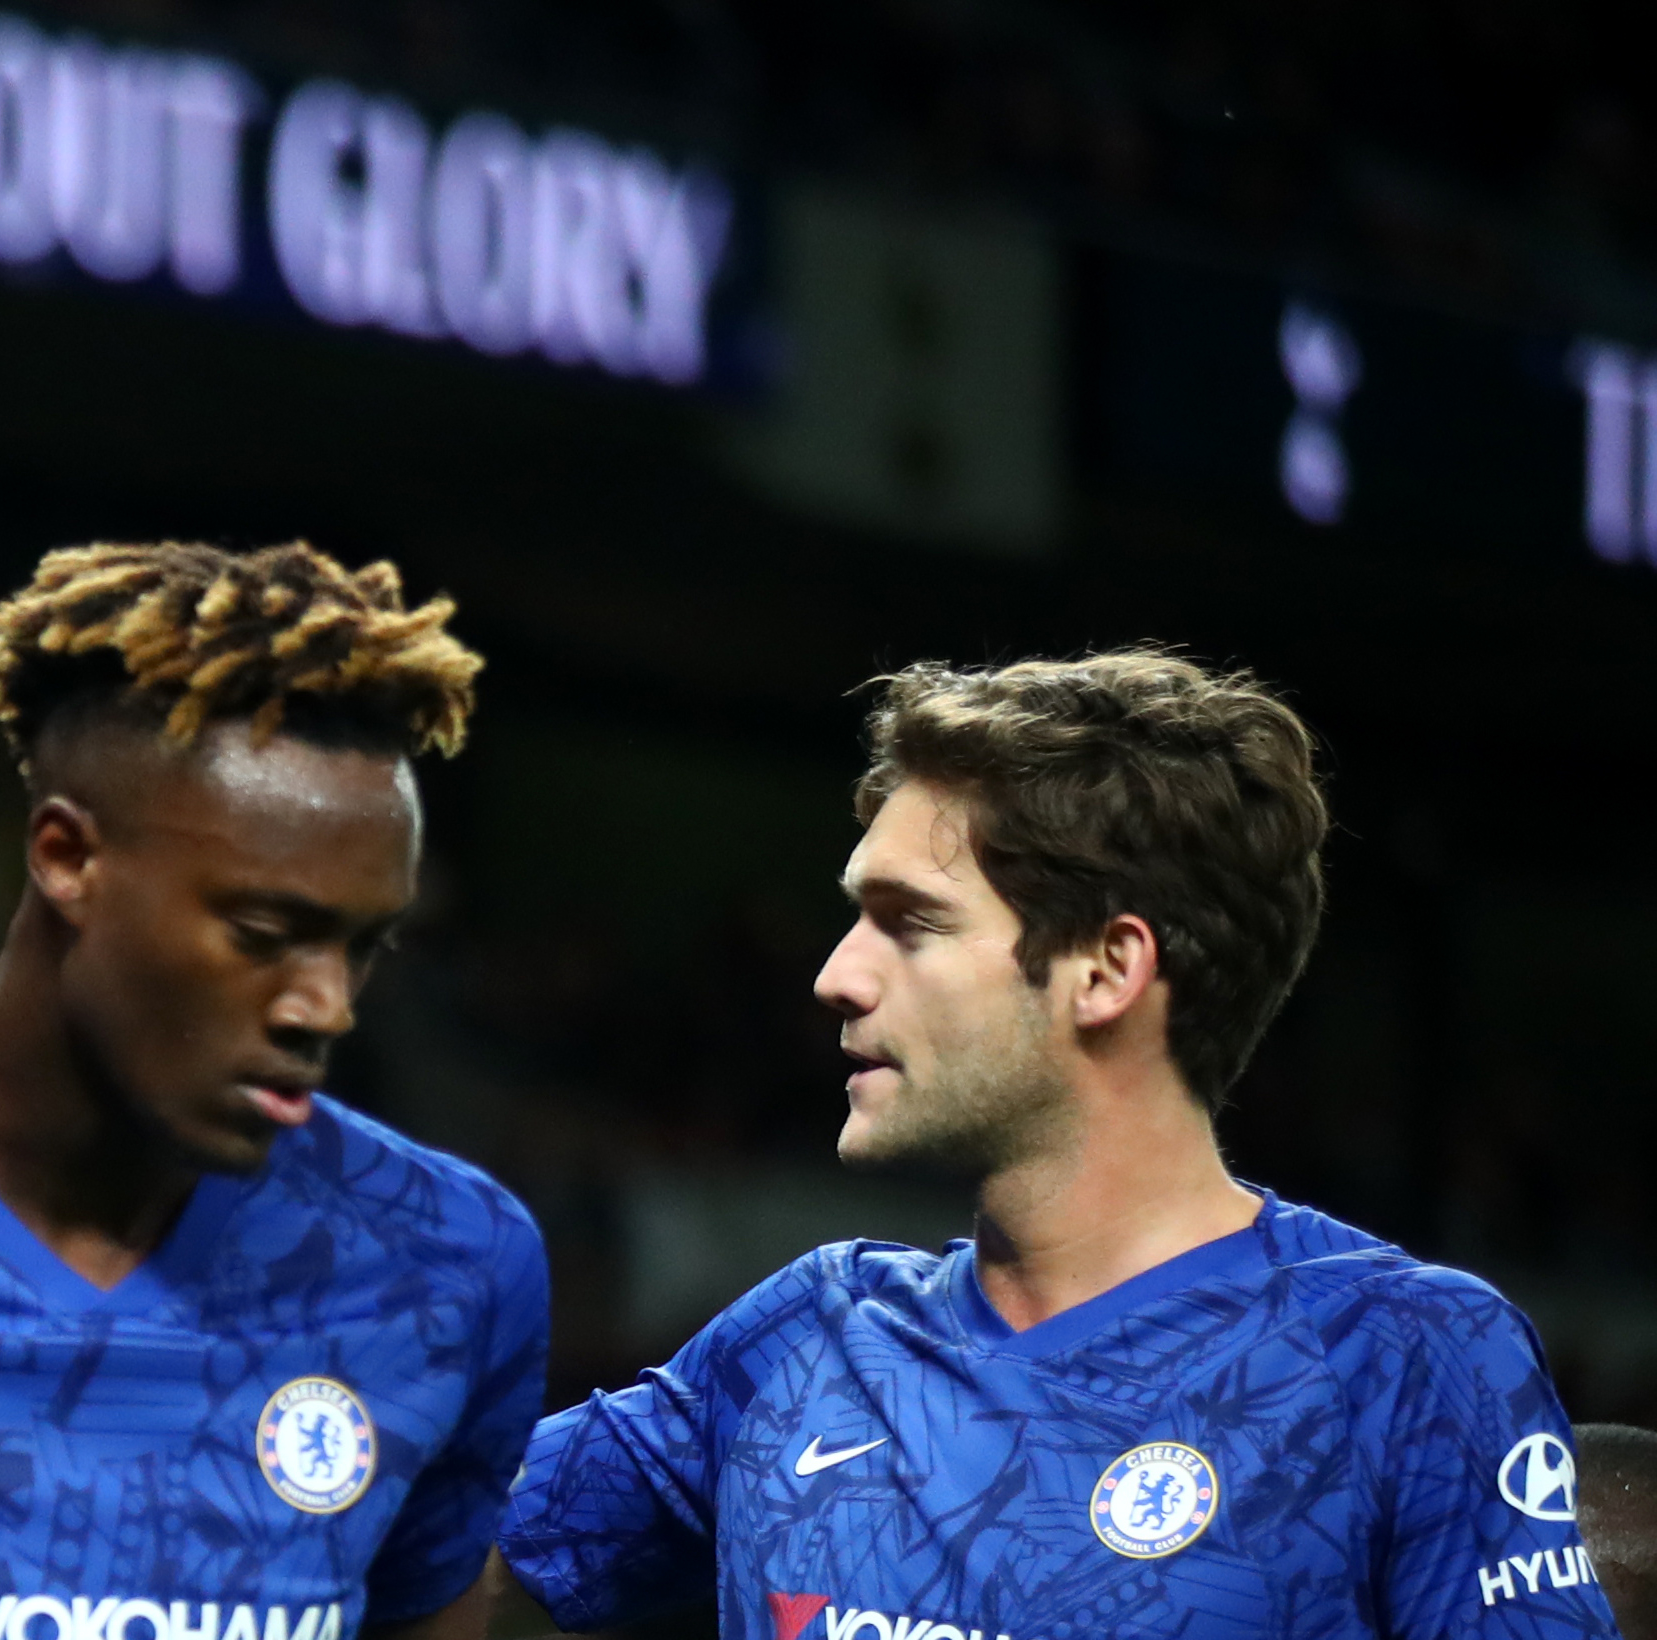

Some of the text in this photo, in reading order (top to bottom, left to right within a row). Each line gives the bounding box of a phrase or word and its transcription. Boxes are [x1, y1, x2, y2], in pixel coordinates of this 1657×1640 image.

[268, 78, 735, 388] GLORY
[1125, 1447, 1204, 1477] CHELSEA
[1102, 1526, 1184, 1553] FOOTBALL CLUB
